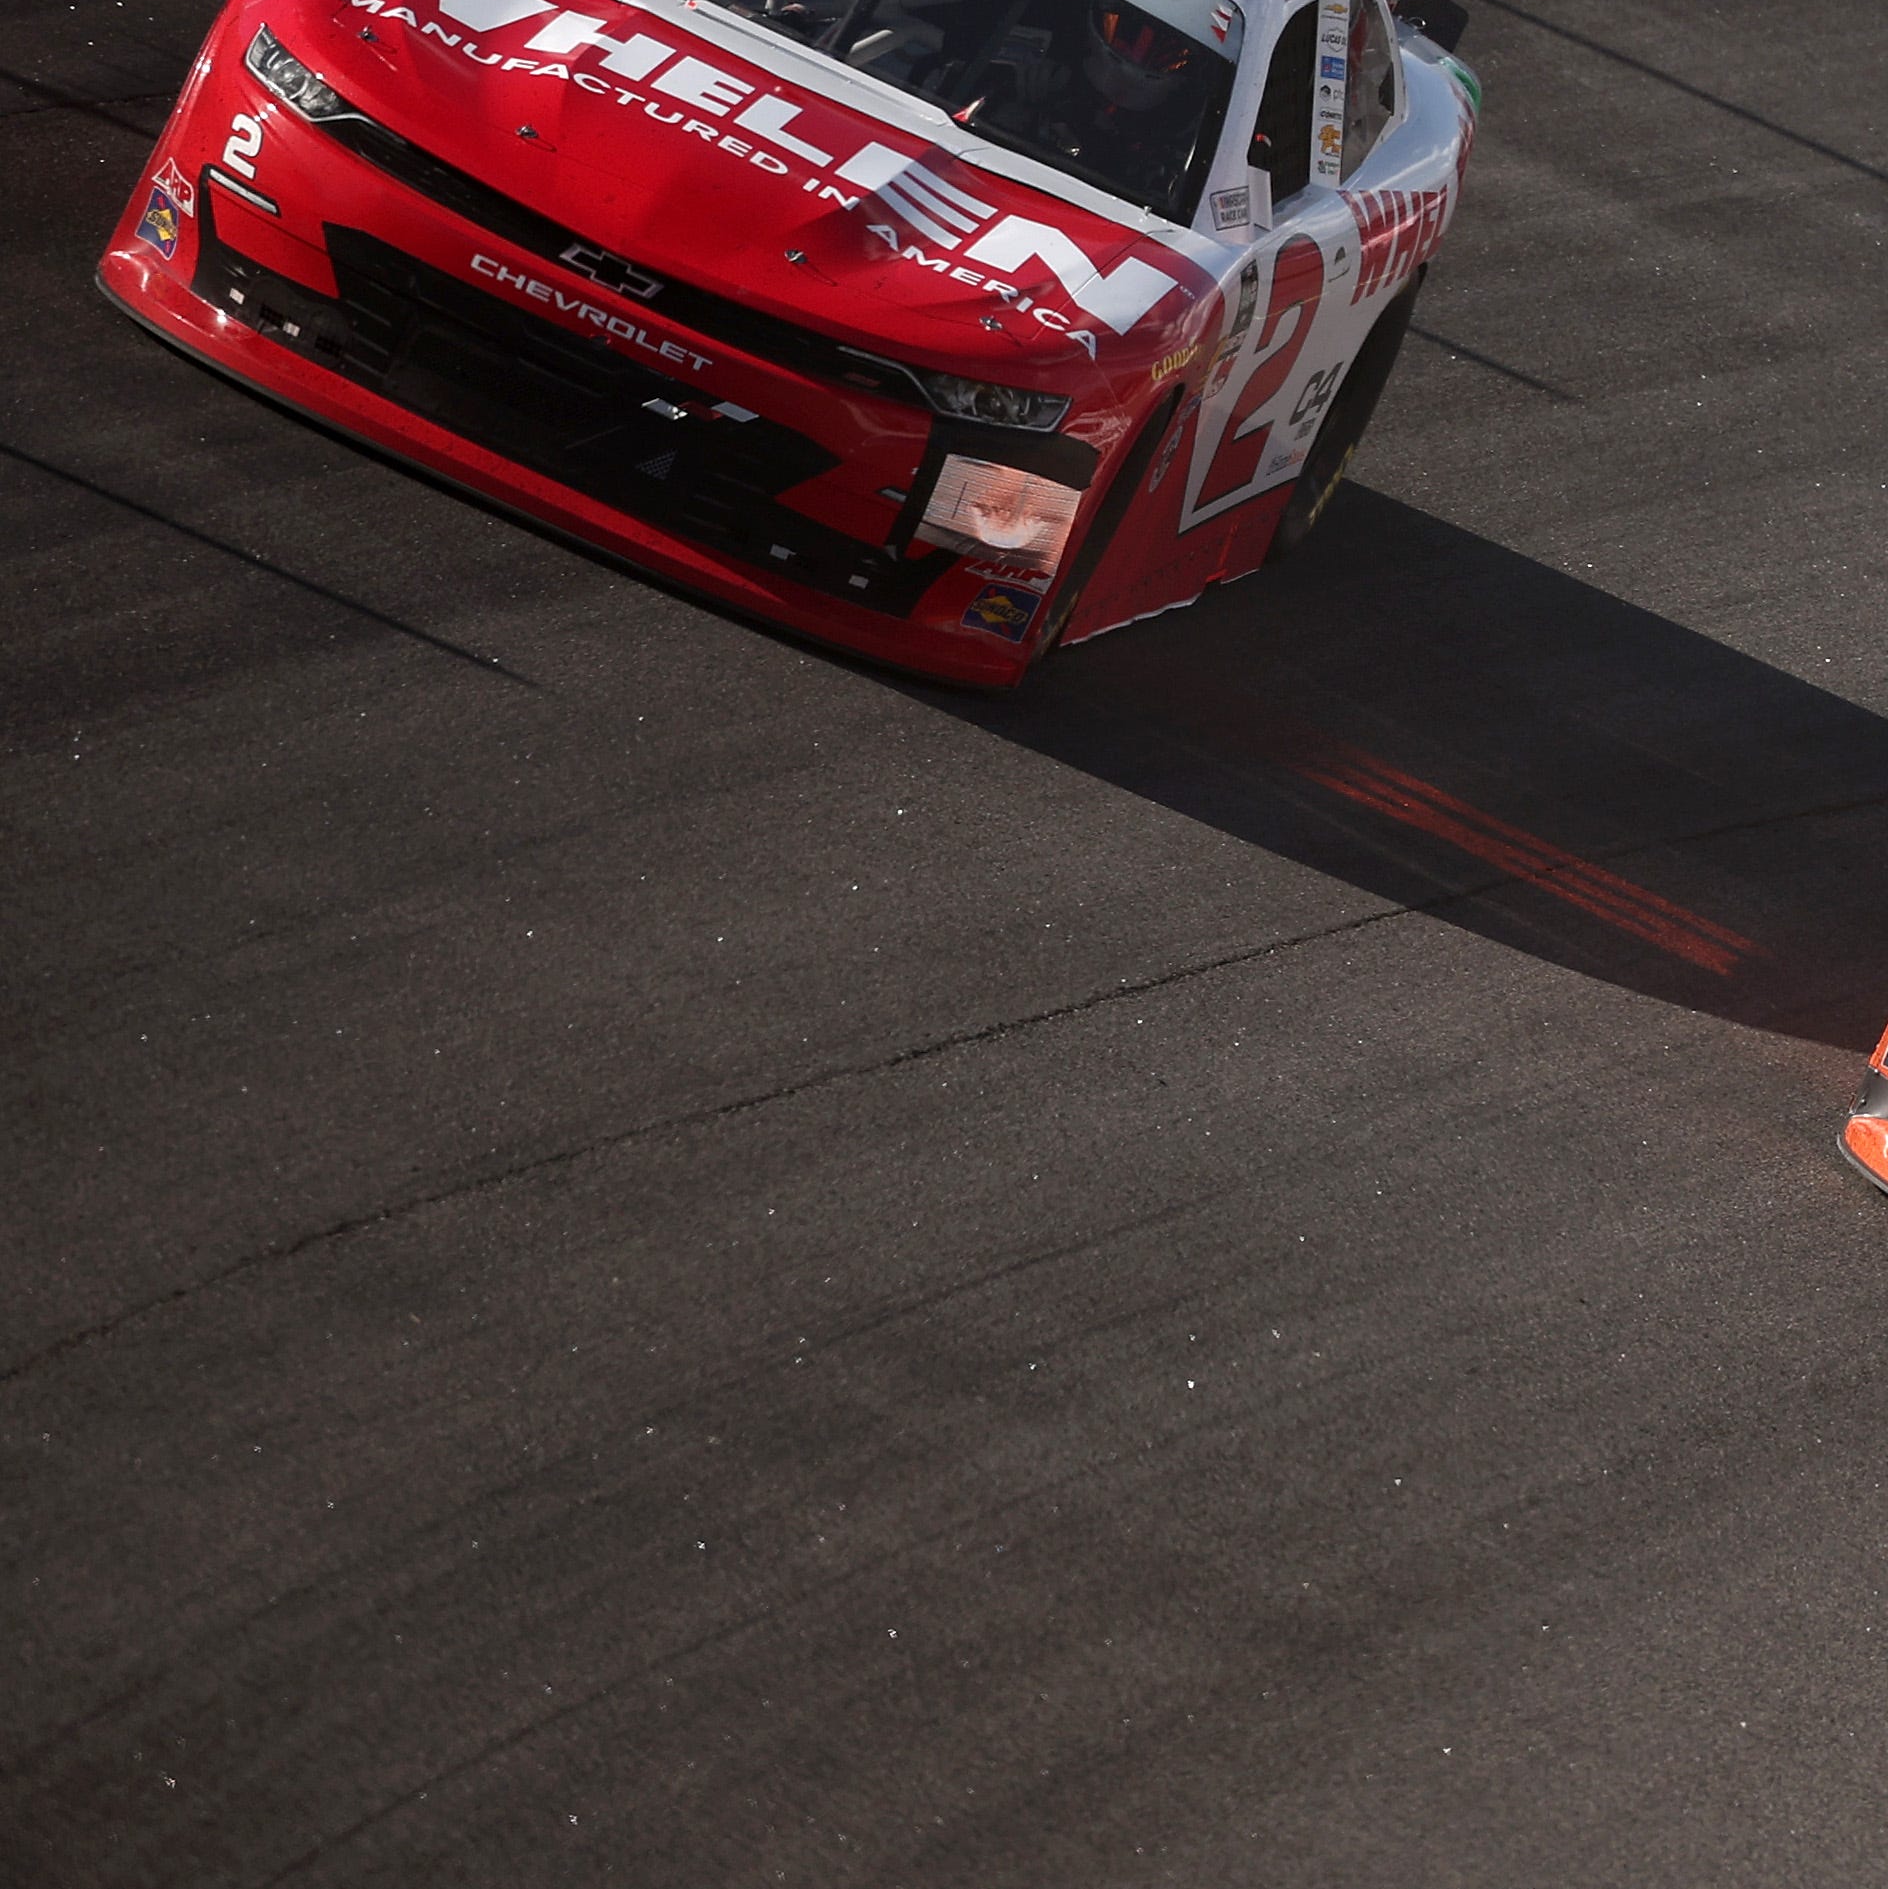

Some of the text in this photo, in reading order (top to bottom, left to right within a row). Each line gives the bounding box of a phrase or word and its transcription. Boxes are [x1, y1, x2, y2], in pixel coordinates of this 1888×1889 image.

[222, 113, 263, 181] 2
[803, 173, 860, 212] IN
[469, 252, 717, 374] CHEVROLET
[866, 222, 1099, 360] AMERICA
[1190, 231, 1326, 516] 2
